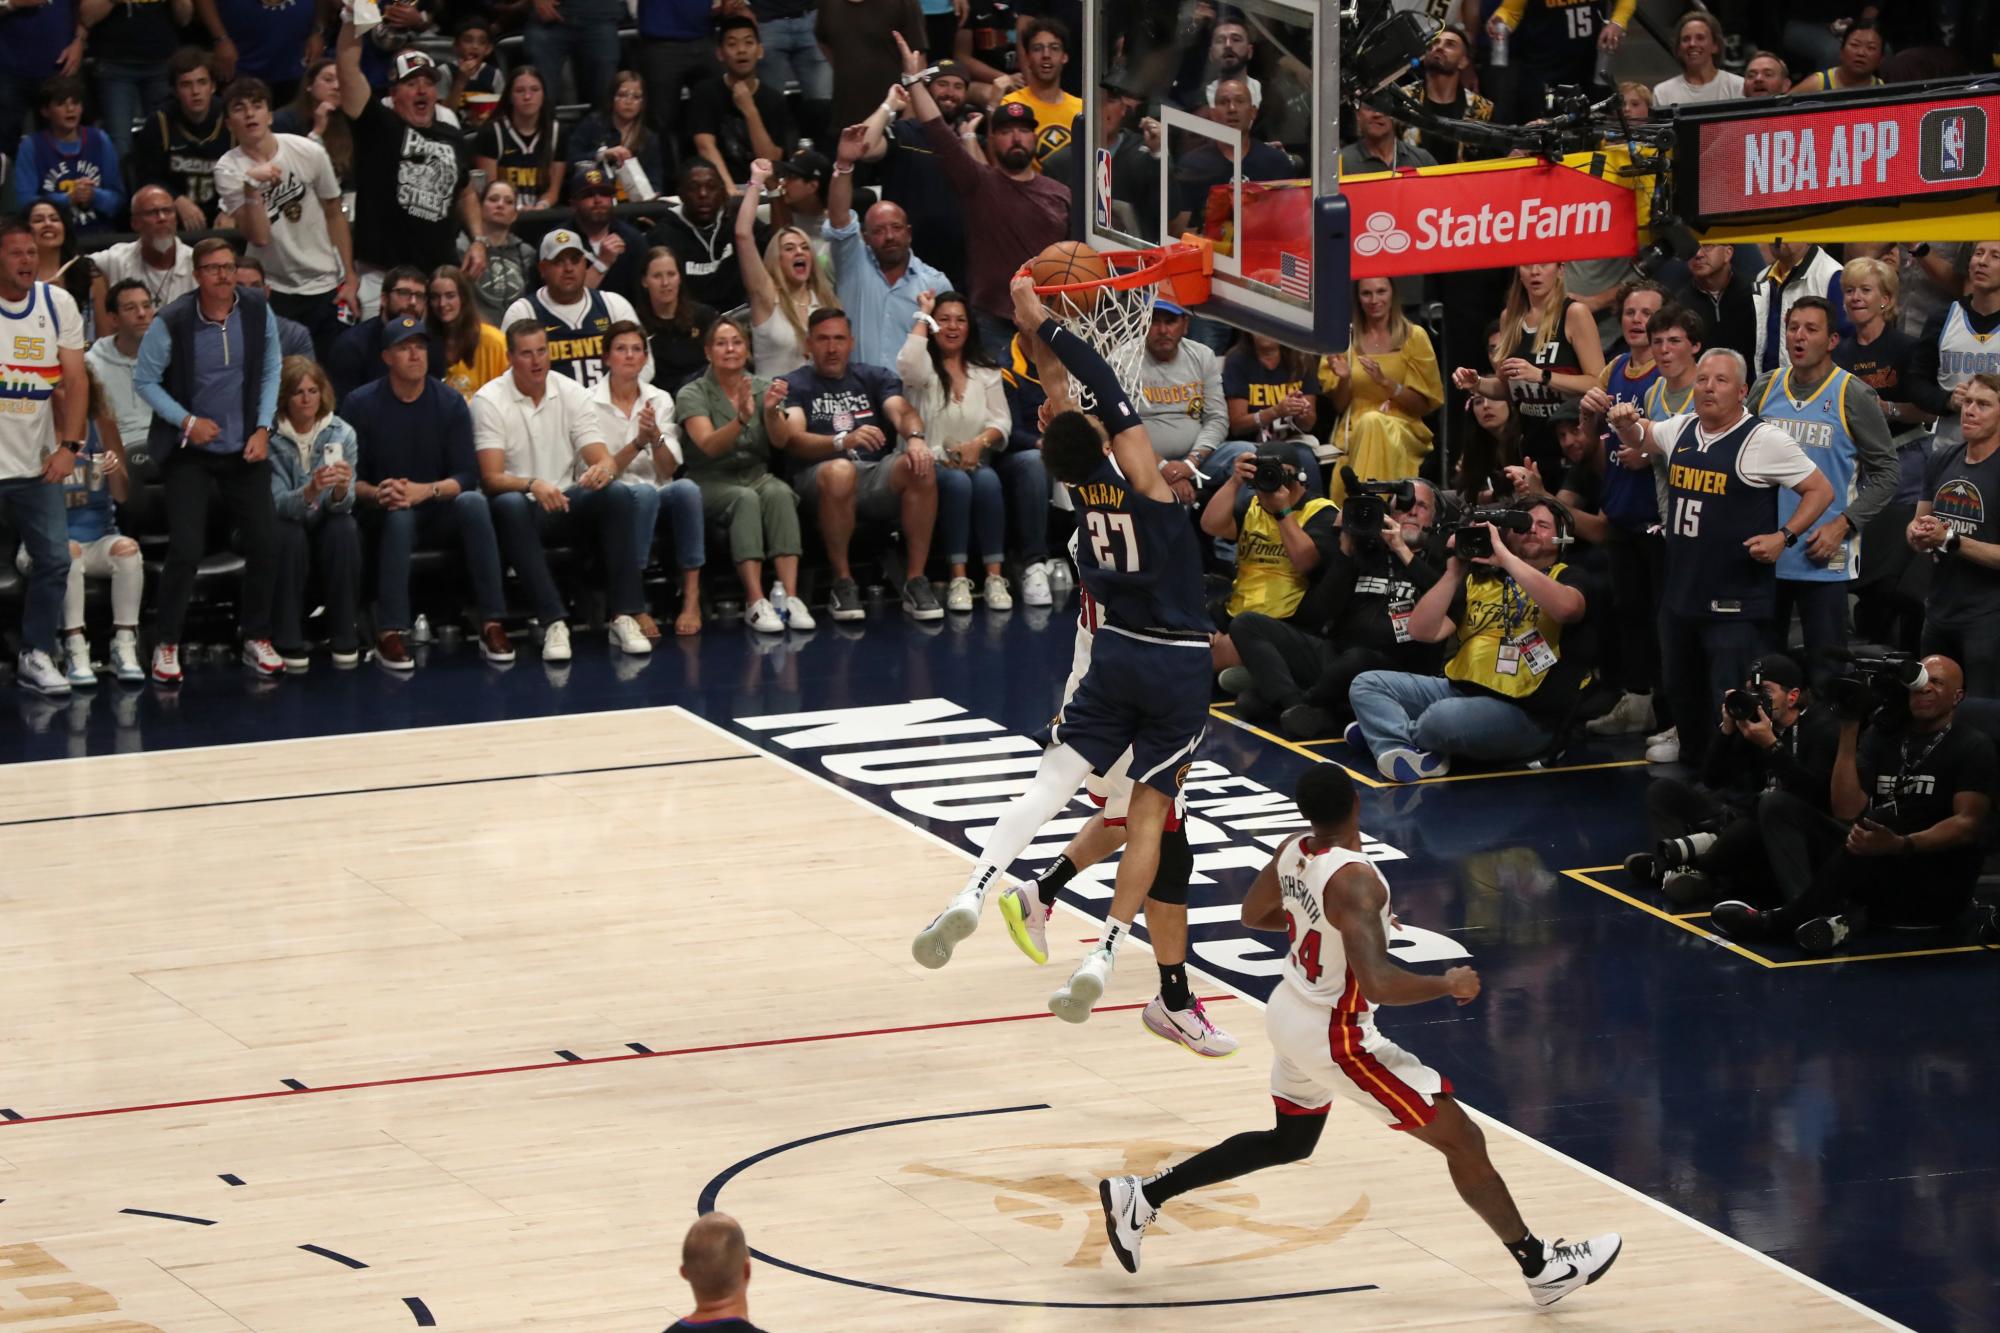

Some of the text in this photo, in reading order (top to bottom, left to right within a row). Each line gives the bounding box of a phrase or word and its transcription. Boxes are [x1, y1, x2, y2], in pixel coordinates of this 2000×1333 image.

[1566, 6, 1592, 39] 15
[1744, 120, 1899, 196] NBA APP
[43, 162, 70, 191] MILE
[13, 335, 45, 361] 55
[1536, 341, 1560, 365] 27
[1669, 463, 1729, 496] DENVER
[1673, 497, 1703, 538] 15
[1086, 511, 1140, 573] 27
